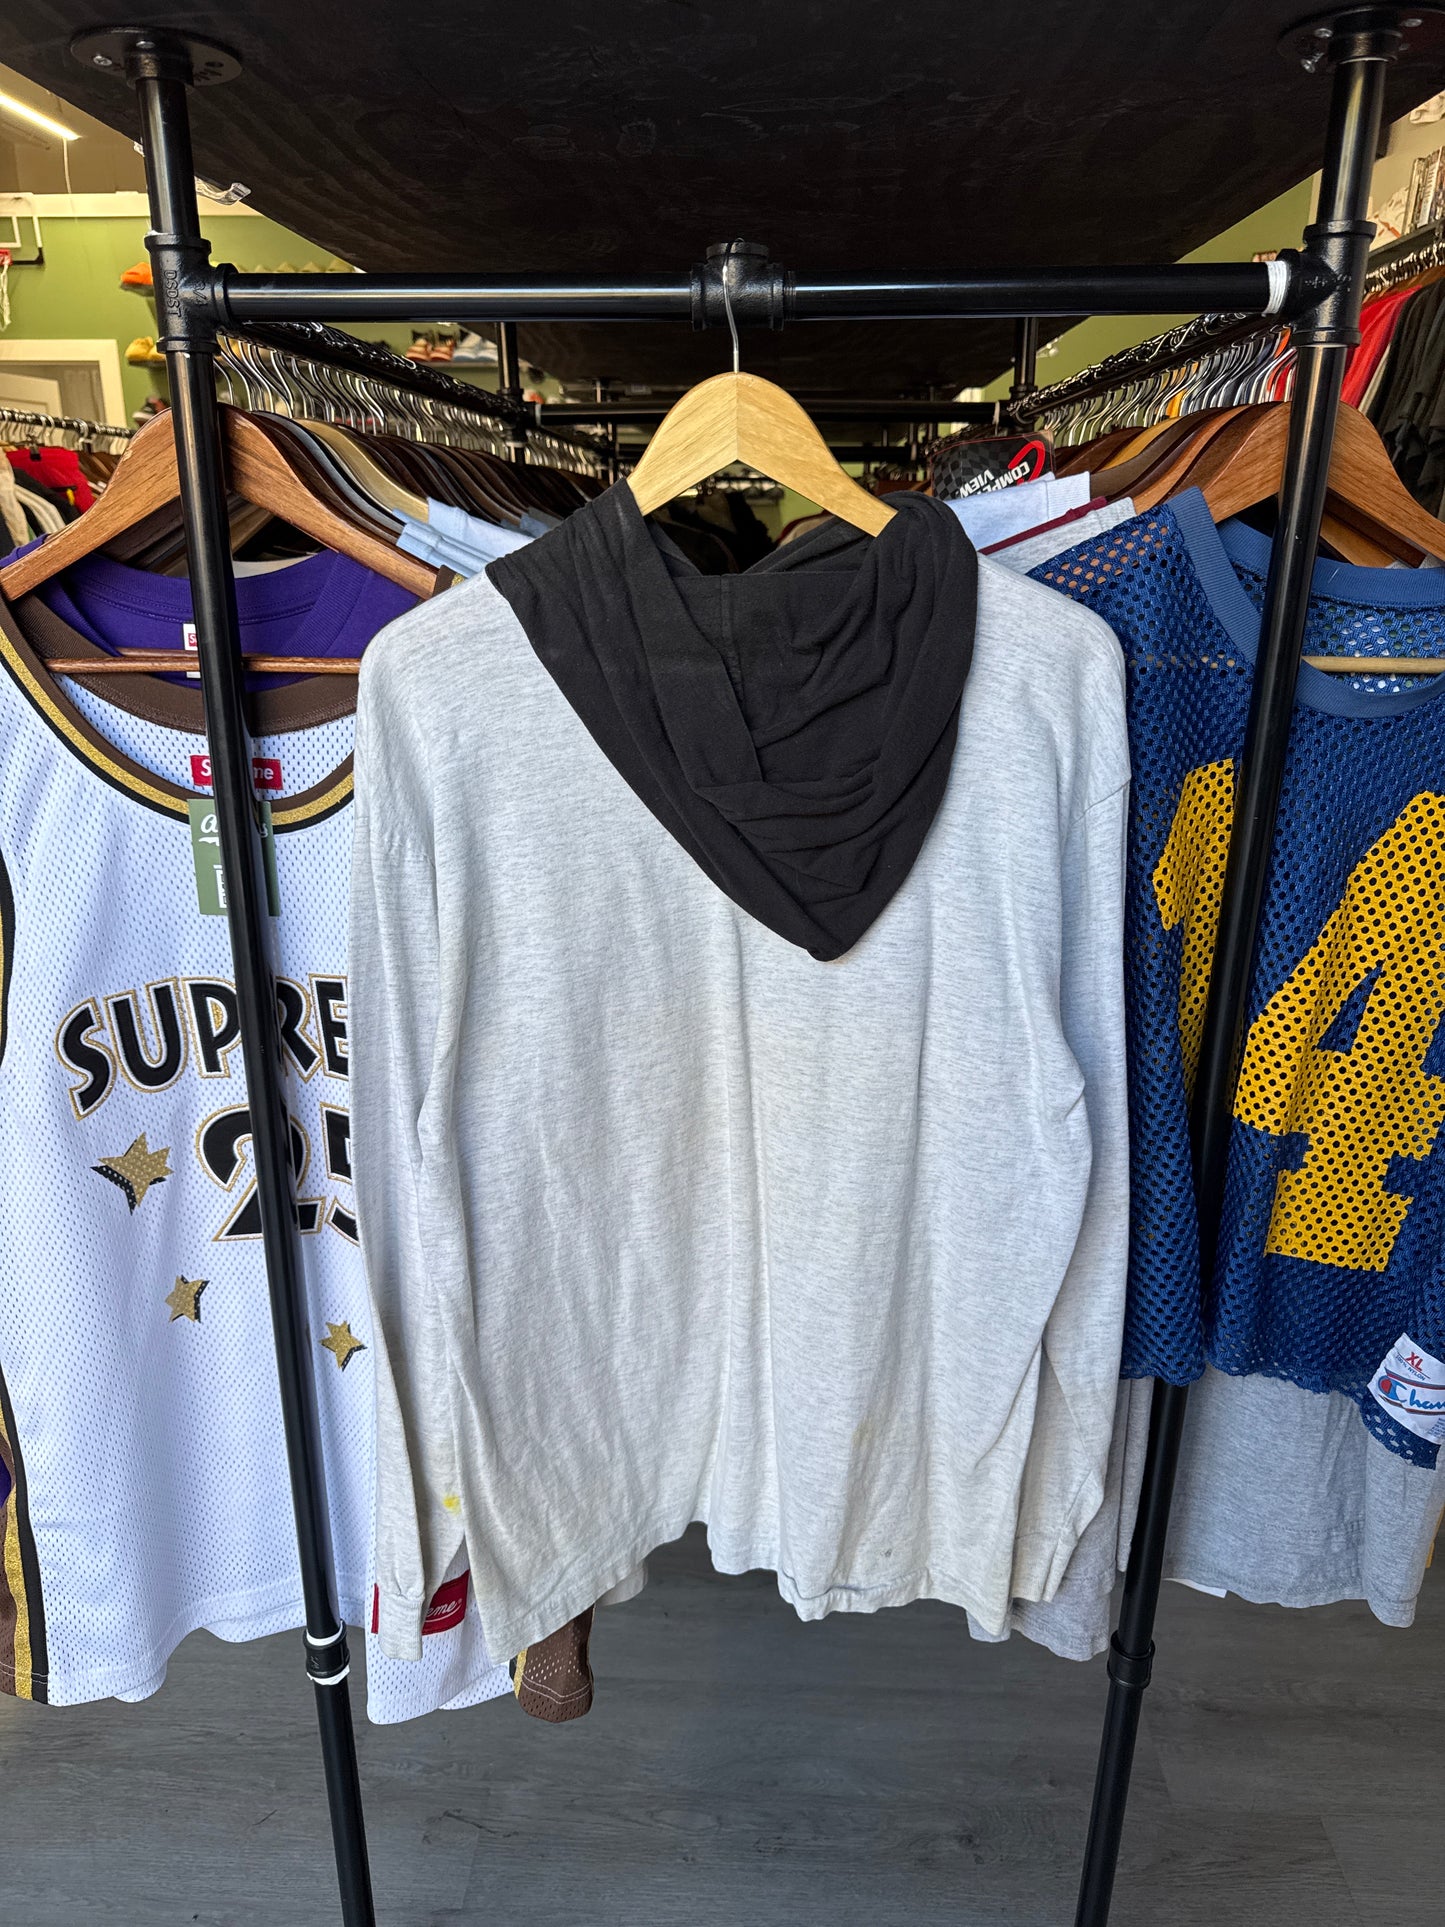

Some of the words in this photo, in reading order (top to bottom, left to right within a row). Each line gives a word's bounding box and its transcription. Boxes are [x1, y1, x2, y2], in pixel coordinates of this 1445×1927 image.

[164, 269, 182, 318] DSDST
[55, 973, 350, 1122] SUPRE
[1404, 1351, 1424, 1372] XL
[1407, 1366, 1426, 1381] NYLON
